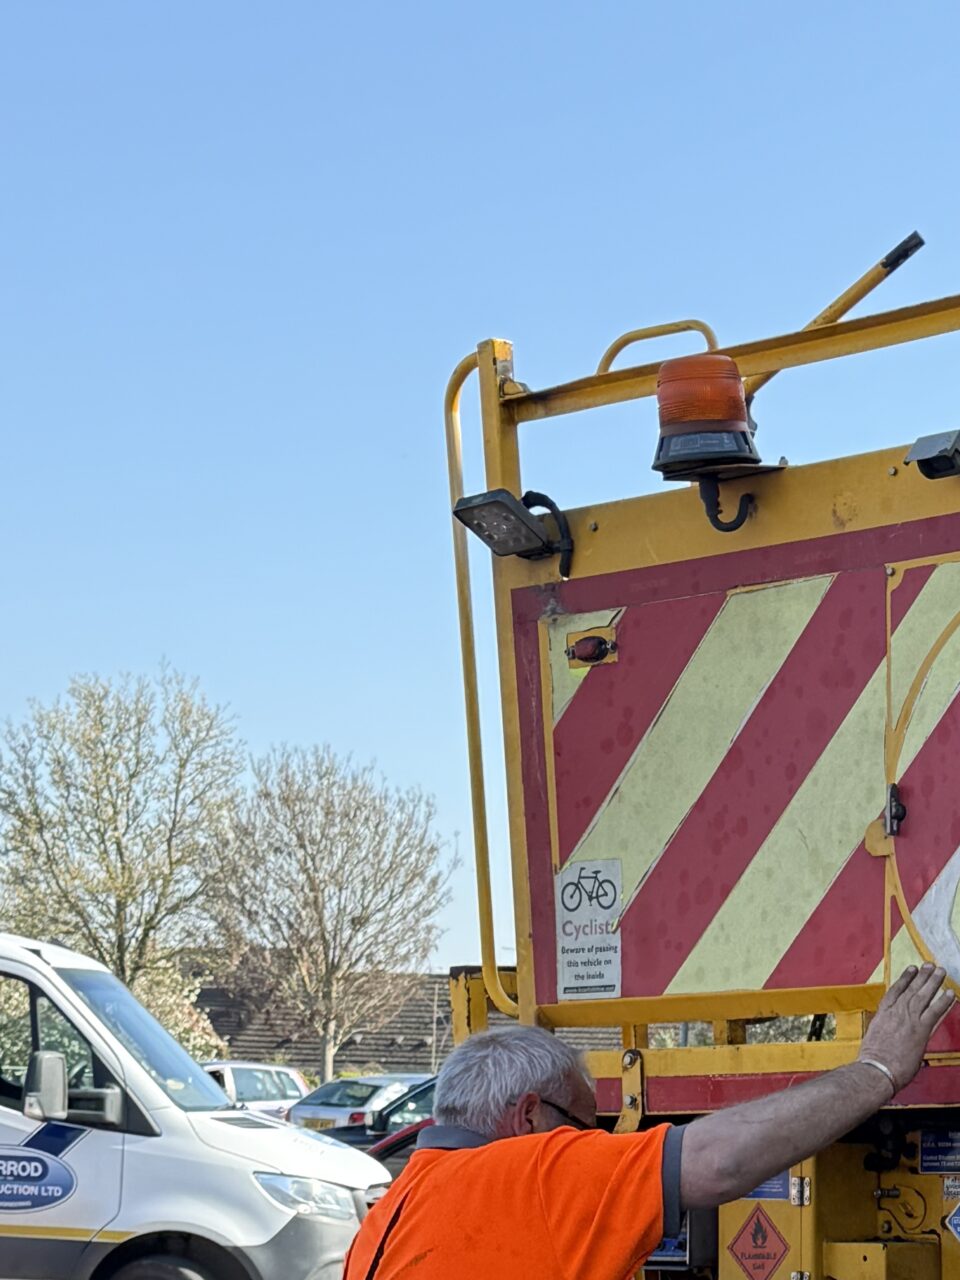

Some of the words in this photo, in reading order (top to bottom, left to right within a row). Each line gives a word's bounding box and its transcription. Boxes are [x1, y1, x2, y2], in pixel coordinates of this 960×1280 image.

[562, 919, 613, 941] Cyclist
[561, 946, 586, 954] Beware
[587, 944, 593, 953] of
[594, 944, 618, 955] passing
[580, 958, 602, 967] vehicle
[586, 971, 605, 980] inside
[41, 1186, 63, 1197] LTD
[740, 1252, 777, 1260] FLAMMABLE
